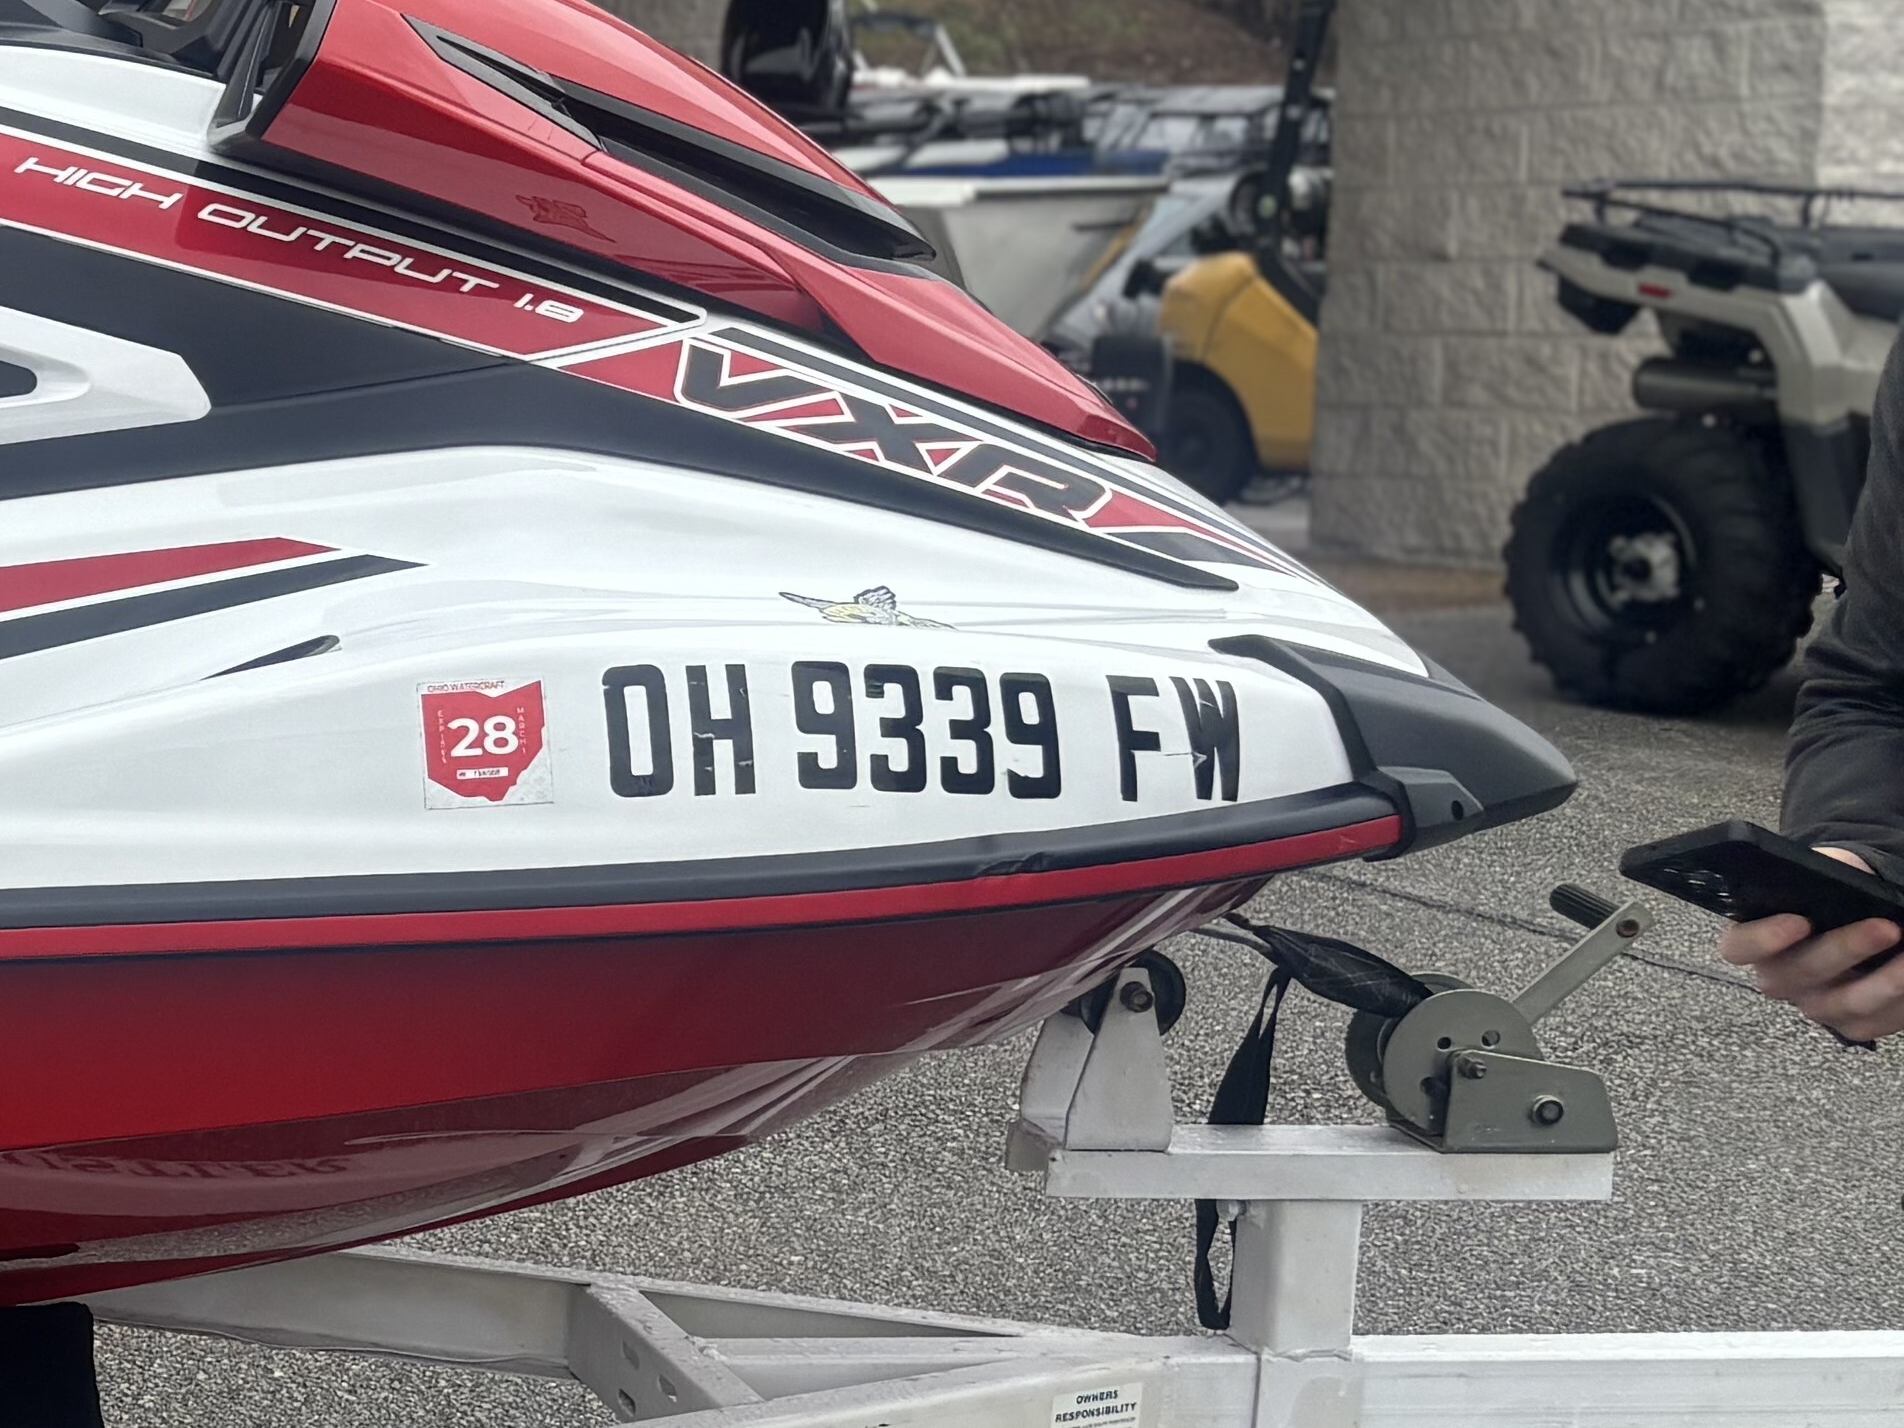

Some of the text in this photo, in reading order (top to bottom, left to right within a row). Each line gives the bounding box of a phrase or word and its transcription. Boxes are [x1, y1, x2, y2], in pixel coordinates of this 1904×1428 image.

[14, 156, 586, 324] HIGH OUTPUT 1.8
[675, 337, 1111, 524] VXR
[451, 680, 505, 691] WATERCRAFT
[447, 715, 519, 758] 28
[603, 663, 756, 798] OH
[791, 660, 1062, 800] 9339
[1055, 1402, 1138, 1423] RESPONSIBILITY
[1076, 1389, 1119, 1405] OWNERS
